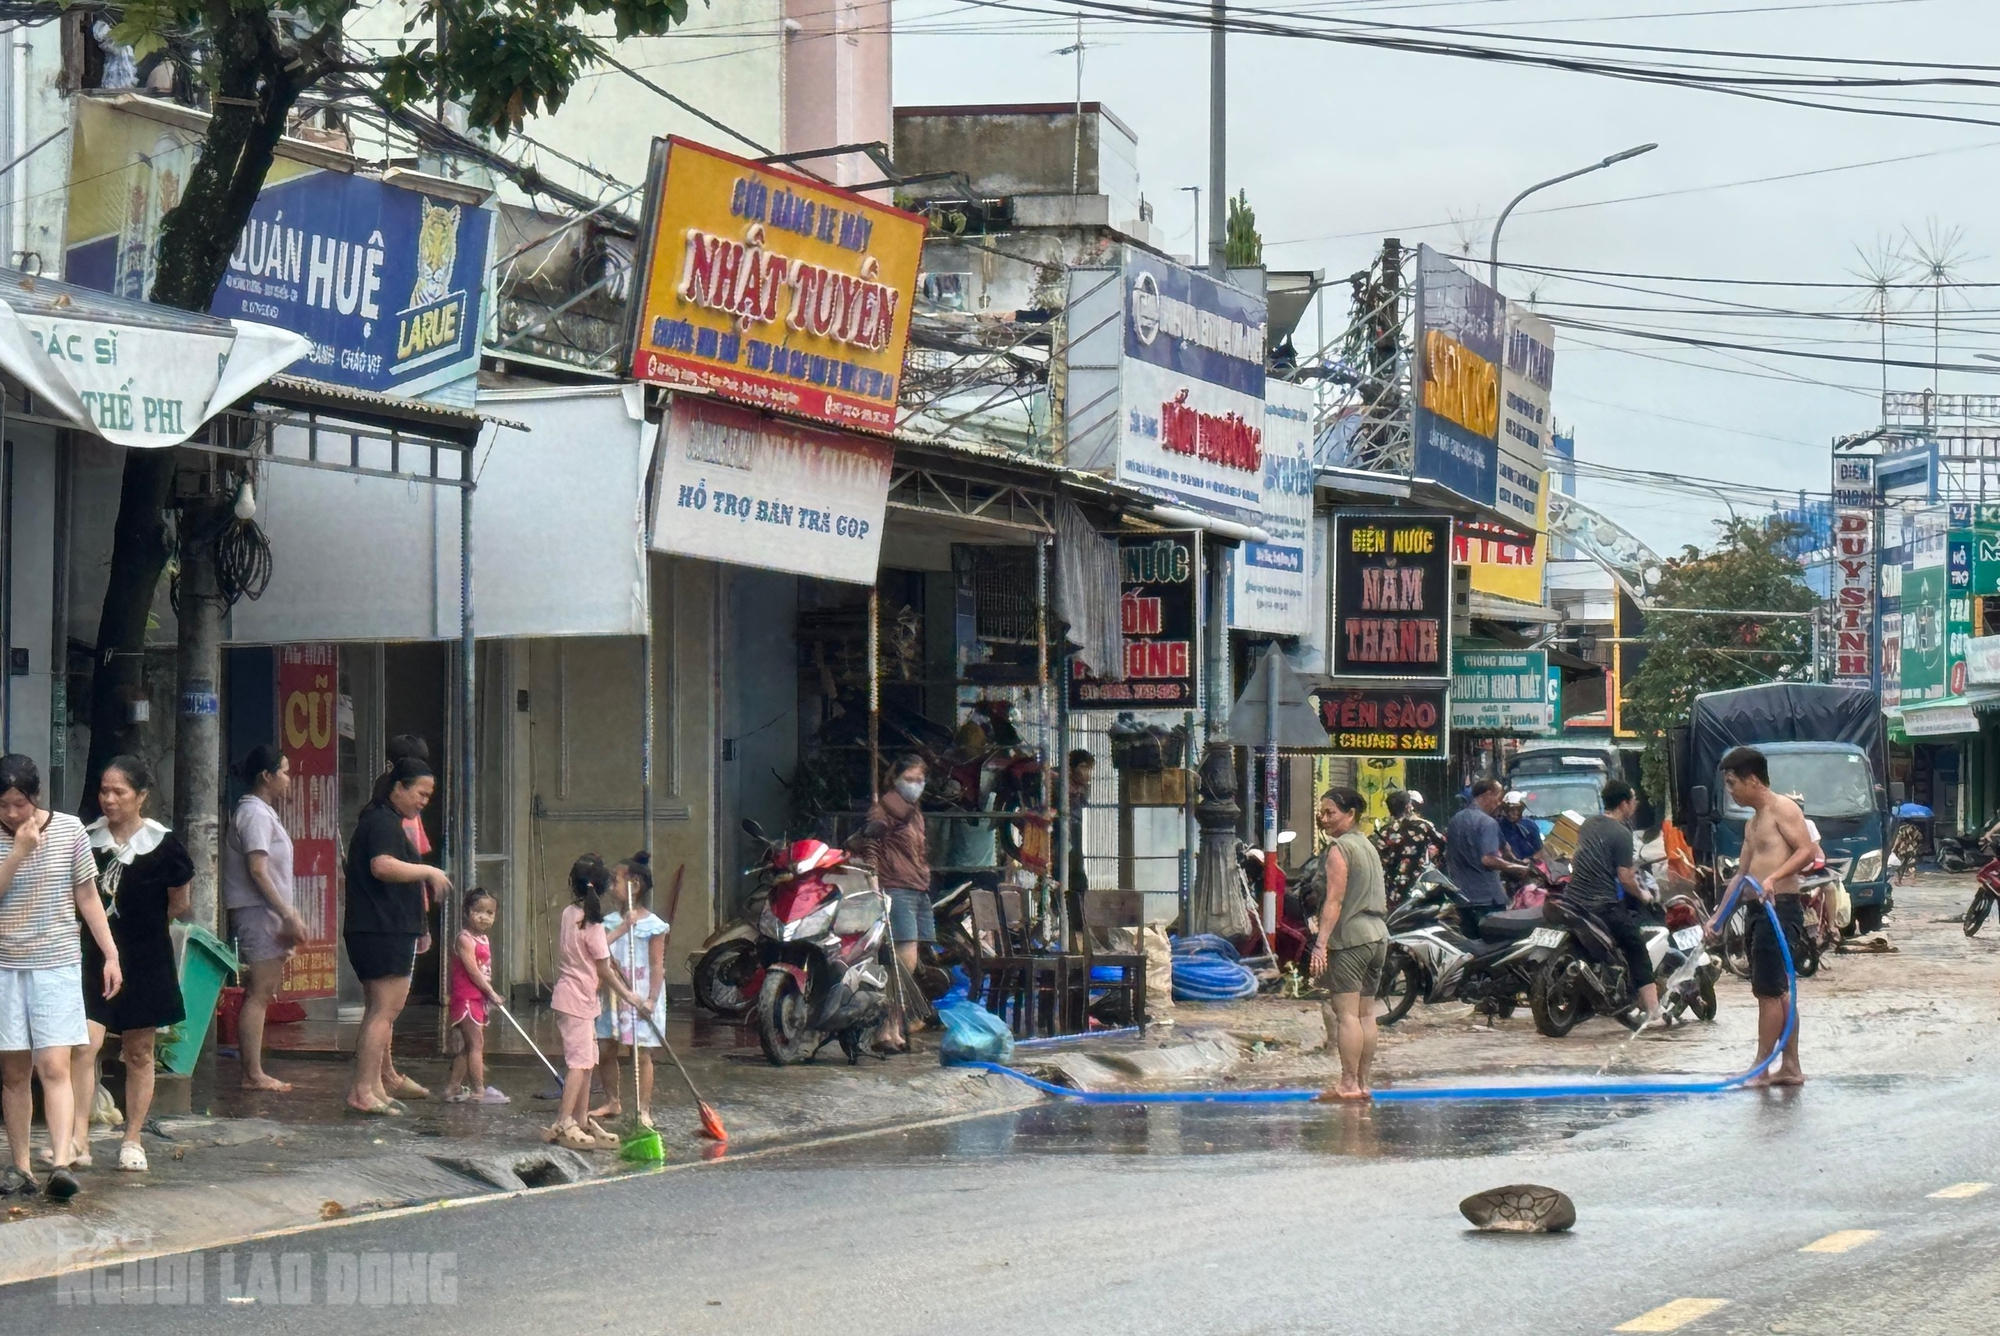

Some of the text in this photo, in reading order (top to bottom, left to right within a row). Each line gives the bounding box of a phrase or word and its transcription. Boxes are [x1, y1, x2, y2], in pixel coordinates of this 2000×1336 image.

[307, 230, 384, 338] HUỆ
[677, 222, 787, 332] NHẬT
[397, 301, 458, 360] LARUE
[713, 491, 752, 522] TRỢ
[1345, 618, 1439, 663] THANH
[285, 674, 333, 750] CŨ
